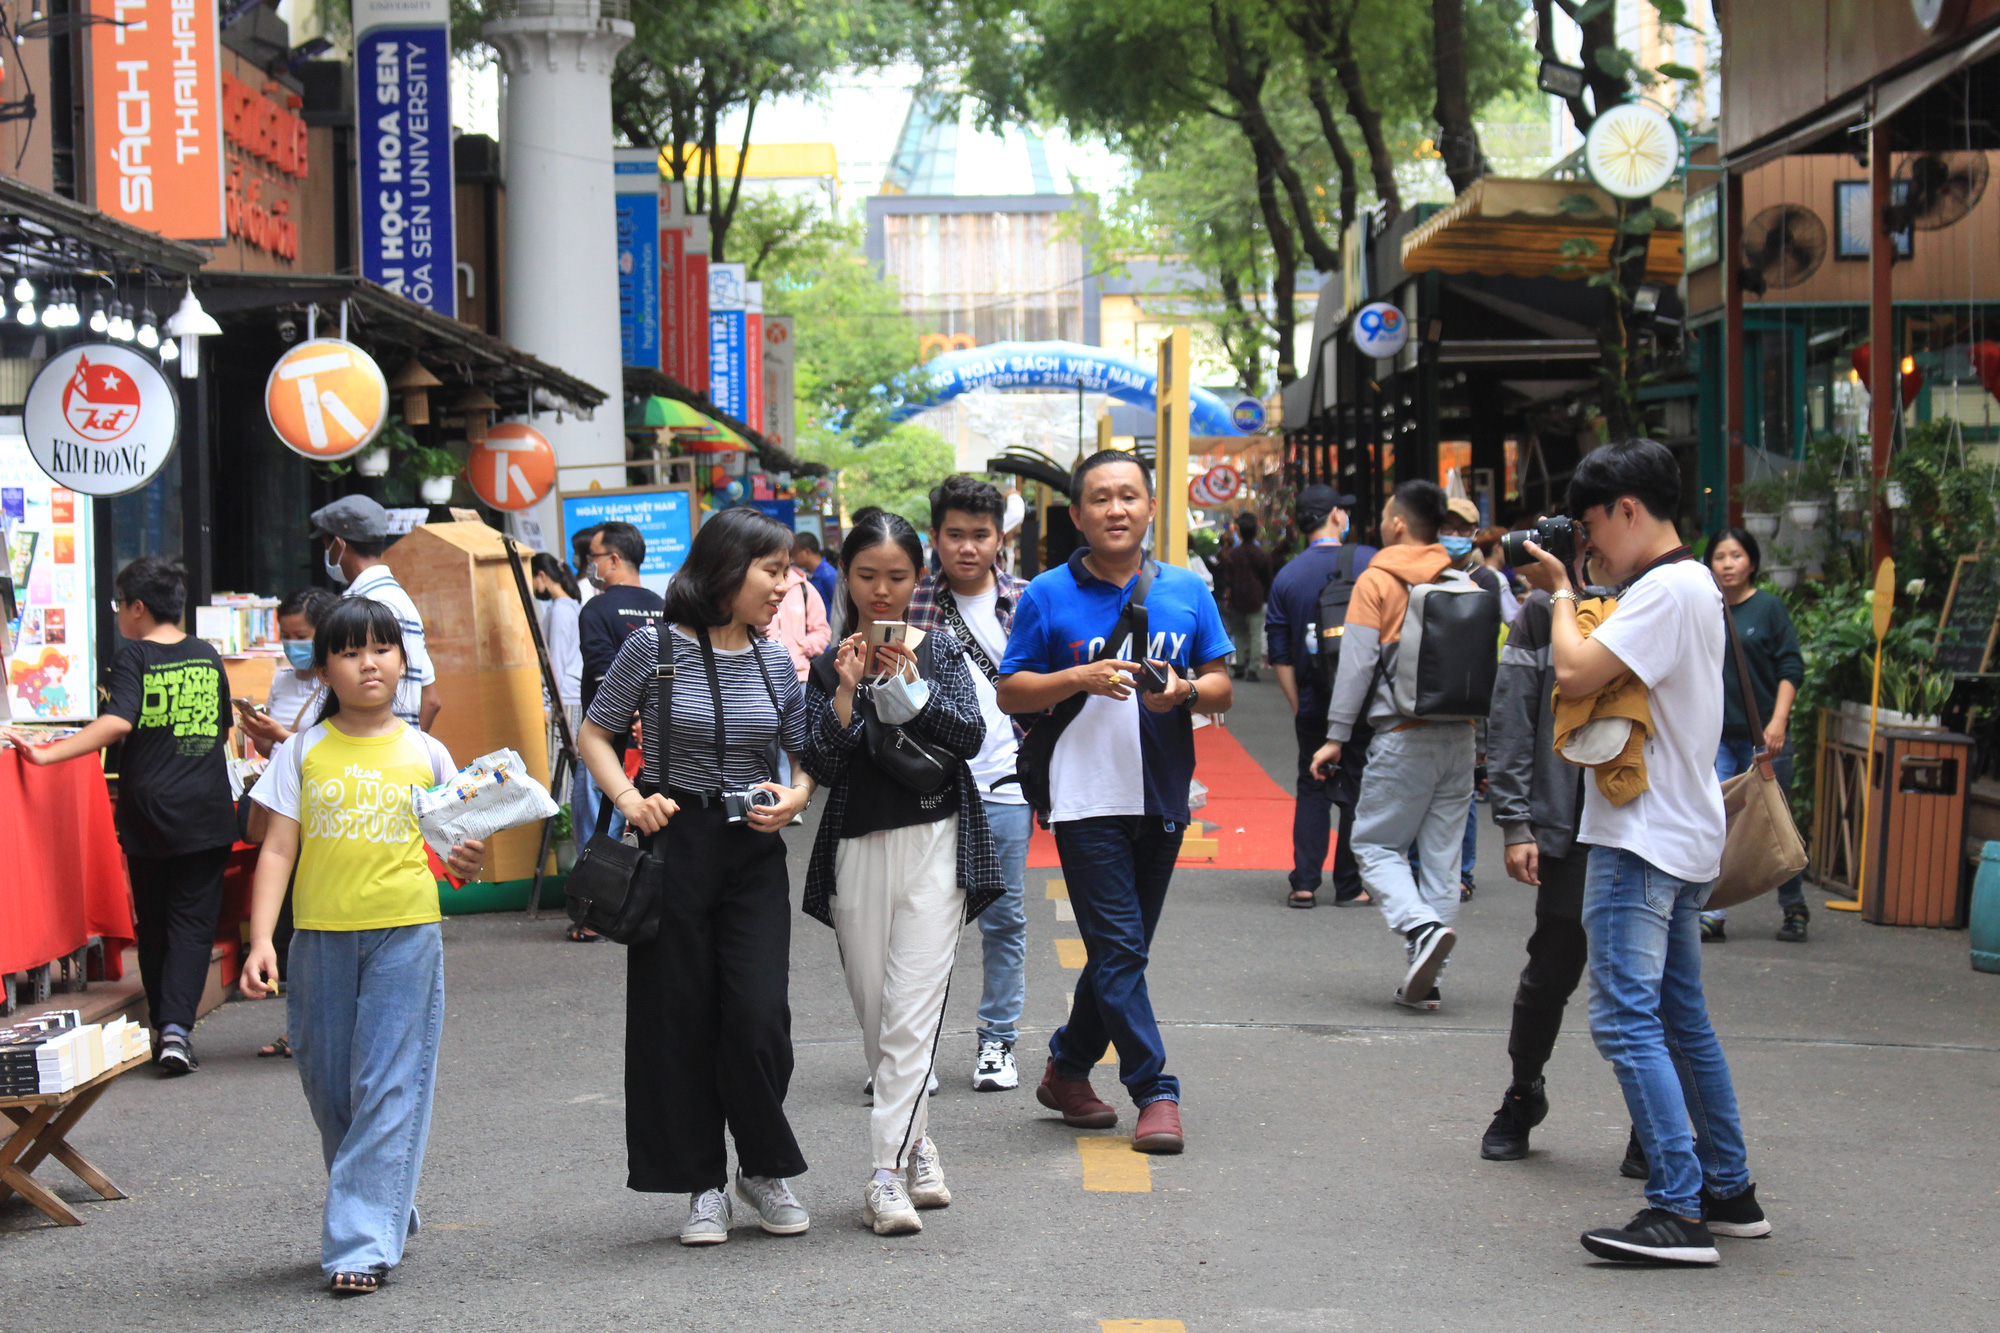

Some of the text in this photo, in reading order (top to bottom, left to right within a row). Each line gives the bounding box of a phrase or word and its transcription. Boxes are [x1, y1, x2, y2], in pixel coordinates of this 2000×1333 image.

[376, 41, 400, 105] SEN
[110, 60, 154, 213] SÁCH
[377, 110, 402, 183] HOA
[405, 41, 435, 311] OA SEN UNIVERSITY
[379, 189, 410, 260] HỌC
[958, 358, 1007, 381] NGÀY
[1010, 352, 1060, 373] SÁCH
[1065, 358, 1107, 377] VIỆT
[1107, 365, 1147, 391] NAM
[52, 438, 88, 473] KIM
[605, 502, 632, 515] SÁCH
[653, 501, 677, 511] NAM
[184, 666, 219, 682] YOUR
[138, 714, 168, 729] FOR
[173, 722, 218, 737] STARS
[344, 763, 384, 780] please
[307, 778, 345, 808] DO
[356, 780, 412, 814] NOT
